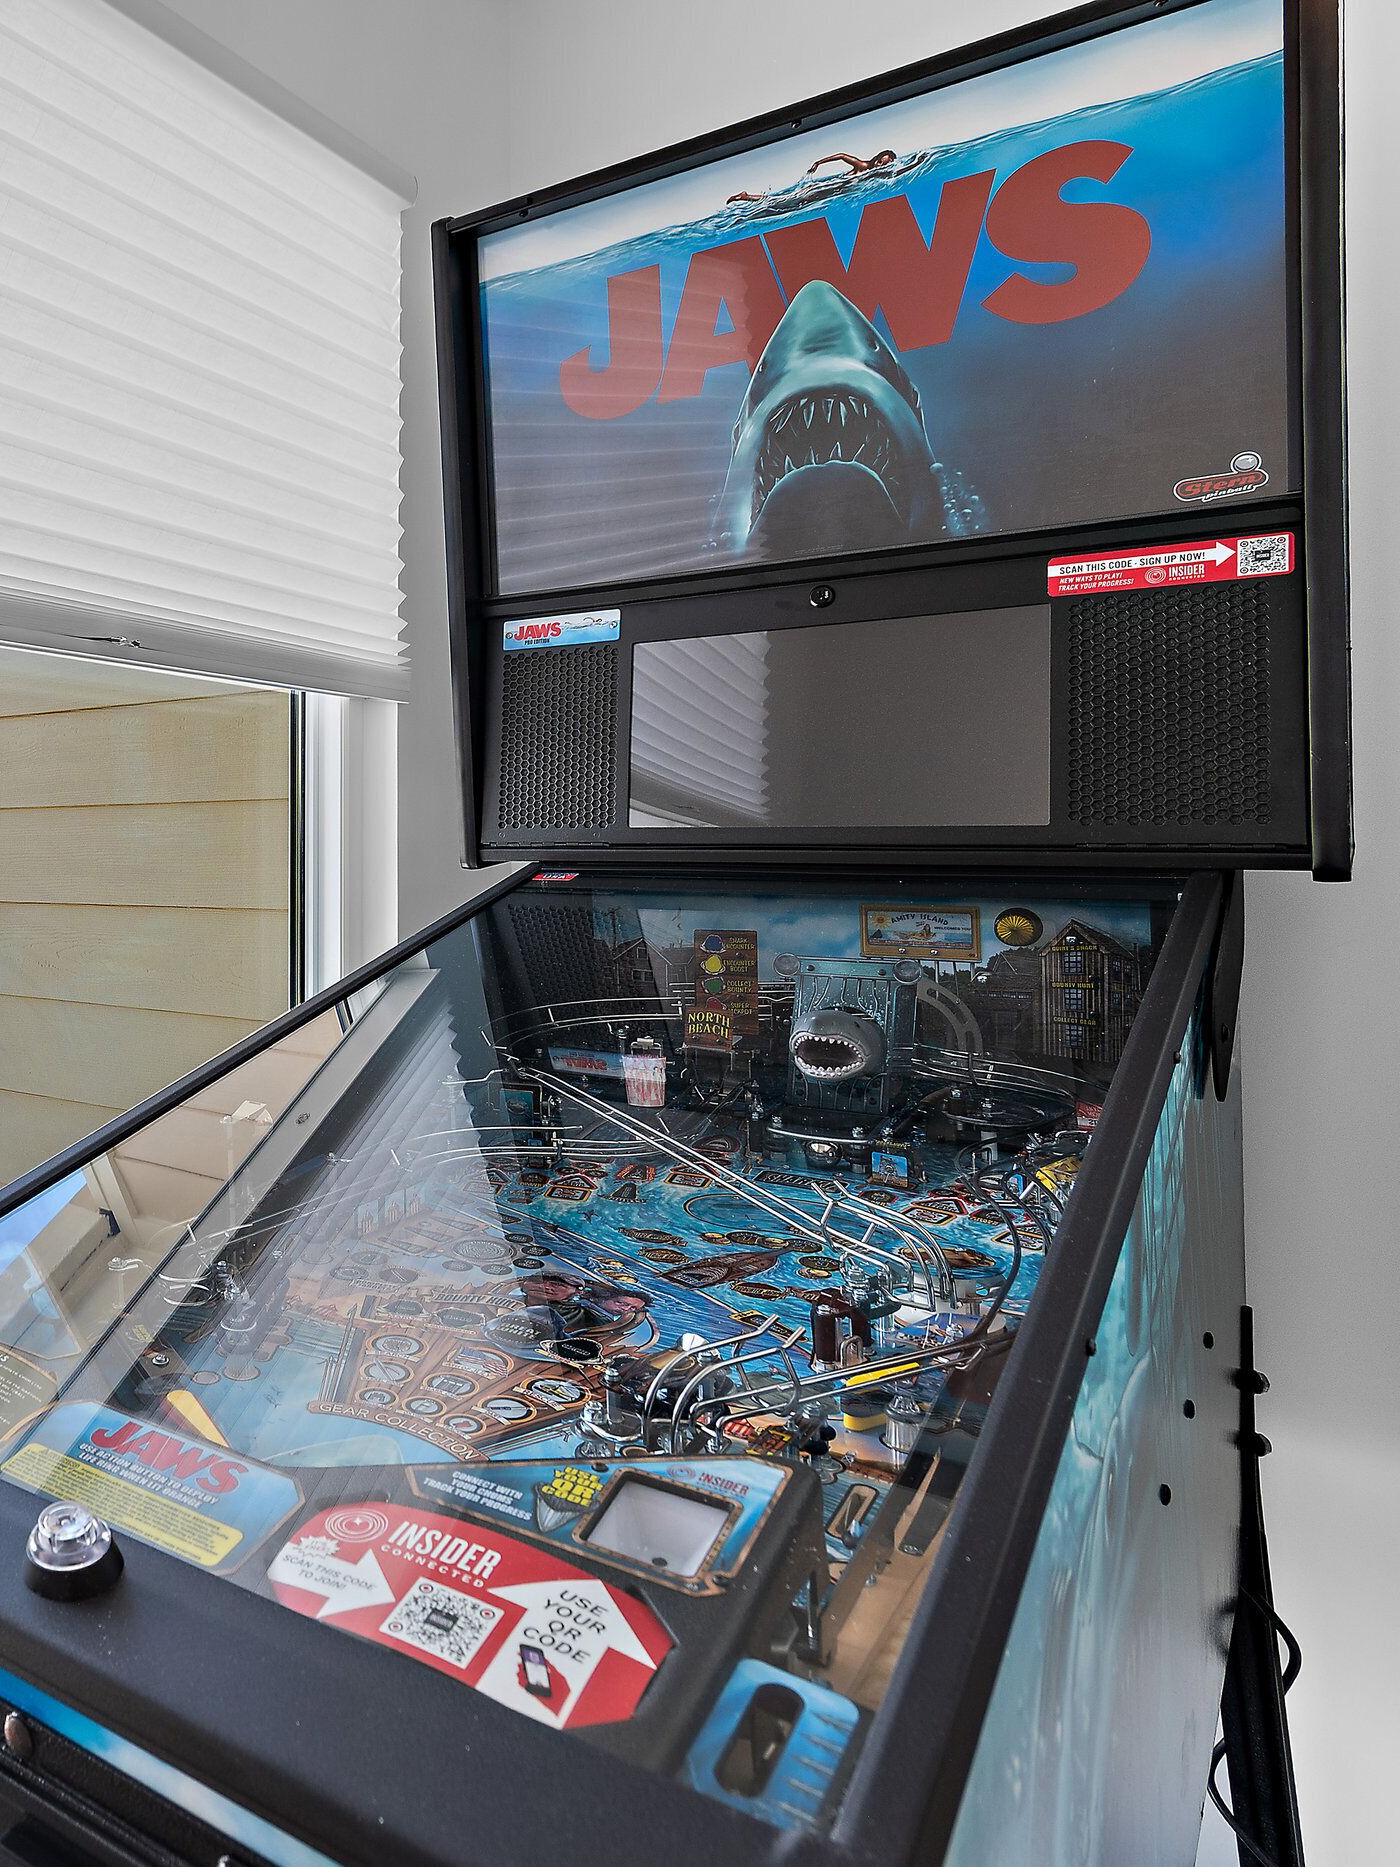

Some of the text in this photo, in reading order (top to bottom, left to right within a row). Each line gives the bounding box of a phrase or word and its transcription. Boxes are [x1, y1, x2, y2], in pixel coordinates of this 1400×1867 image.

[559, 139, 1152, 420] JAWS
[1184, 475, 1257, 496] Stern
[1204, 484, 1254, 500] pinball
[1059, 552, 1206, 575] SCAN THIS CODE SIGN UP NOW!
[1168, 563, 1205, 578] INSIDER
[1058, 578, 1134, 592] TRACK YOUR PROGRESS!
[1076, 575, 1094, 583] WAYS
[1103, 572, 1124, 580] PLAY!
[514, 622, 562, 641] JAWS
[891, 913, 949, 926] AMITY ISLAND
[688, 1011, 730, 1028] NORTH
[688, 1024, 729, 1039] BEACH
[486, 1296, 519, 1309] HUNT
[319, 1403, 370, 1418] GEAR
[375, 1413, 480, 1461] COLLECTION
[90, 1421, 250, 1494] JAWS
[79, 1443, 219, 1504] USE ACTION BUTTON TO DEPLOY
[79, 1452, 203, 1508] LIFE RING WHEN LIT ORANGE
[553, 1469, 605, 1492] YOUR
[564, 1466, 601, 1482] USE
[699, 1472, 749, 1496] INSIDER
[450, 1478, 514, 1505] YOUR CHUMS
[452, 1471, 524, 1500] CONNECT WITH
[541, 1485, 593, 1507] CODE
[552, 1479, 596, 1499] QR
[423, 1476, 533, 1521] TRACK YOUR PROGRESS
[388, 1521, 502, 1580] INSIDER
[282, 1554, 377, 1592] SCAN THIS CODE
[381, 1544, 485, 1588] CONNECTED
[298, 1568, 347, 1591] TO JOIN!
[559, 1590, 609, 1618] USE
[544, 1599, 607, 1634] YOUR
[548, 1620, 582, 1641] QR
[523, 1627, 592, 1664] CODE
